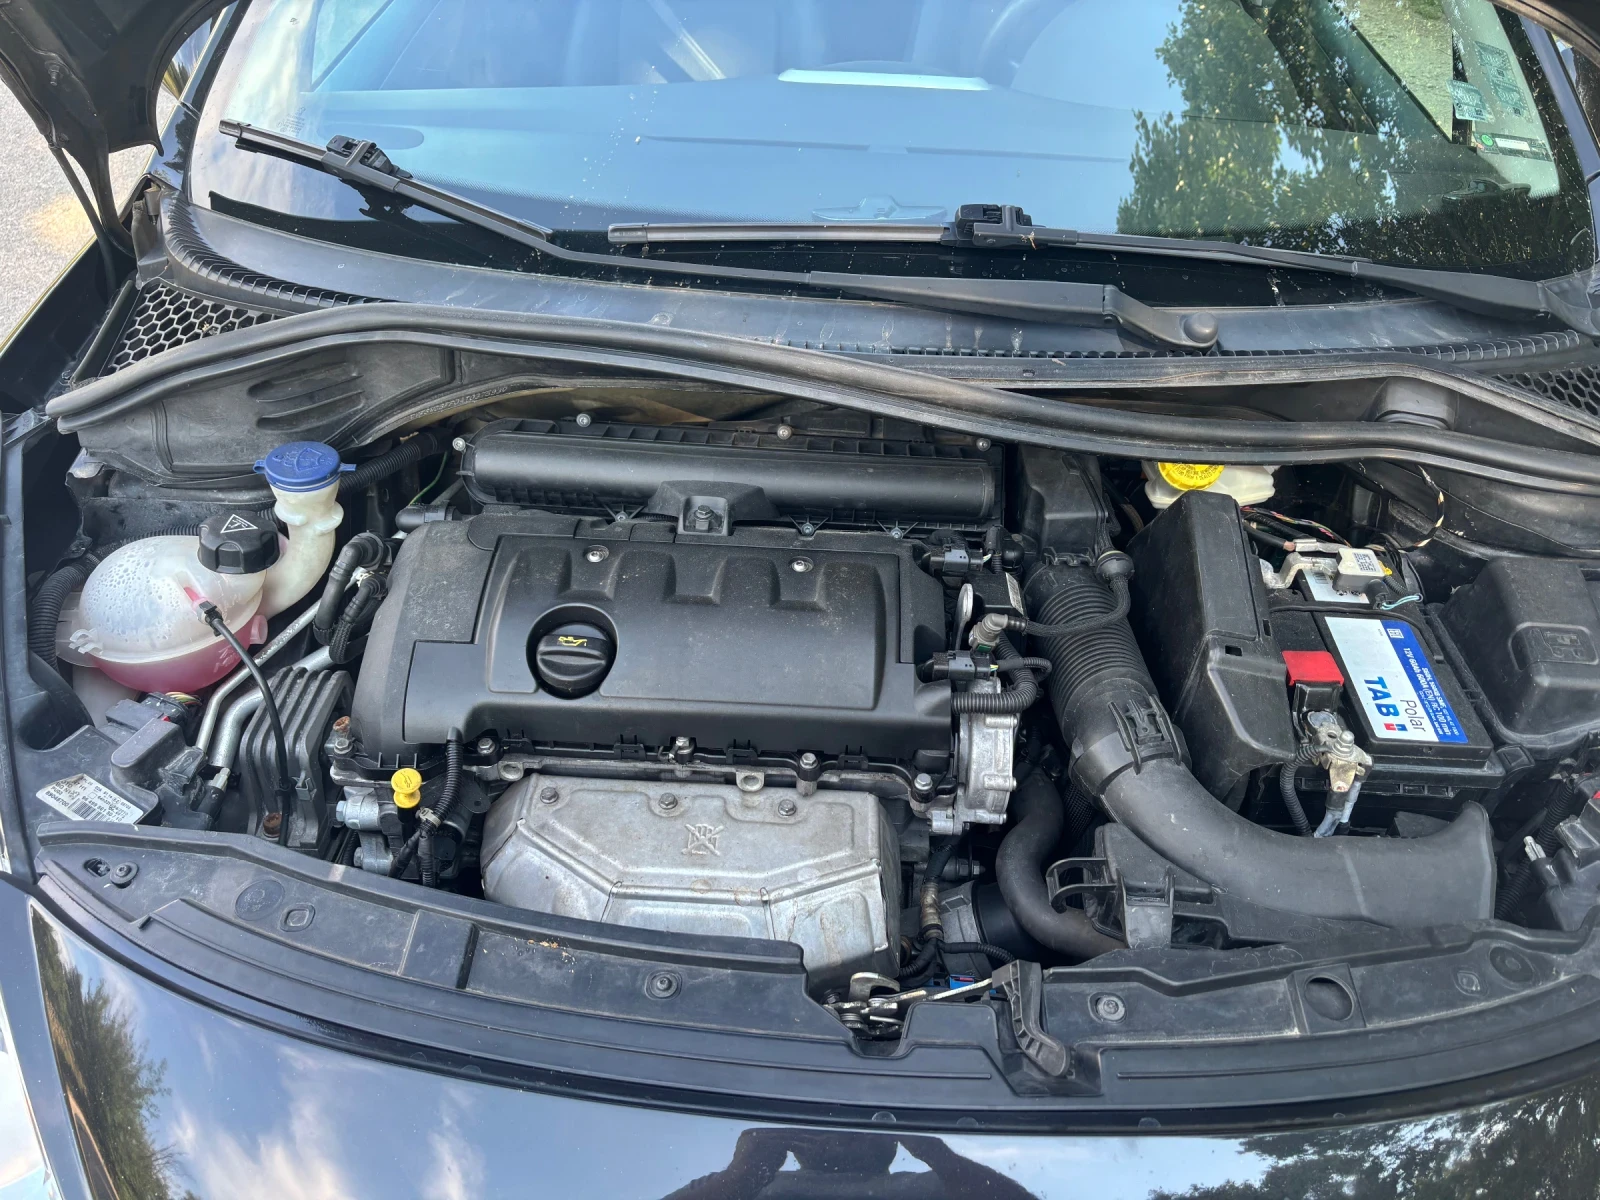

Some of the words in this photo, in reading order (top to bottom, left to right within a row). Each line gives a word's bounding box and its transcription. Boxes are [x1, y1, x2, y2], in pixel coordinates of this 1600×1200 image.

[1363, 676, 1401, 718] TAB
[1403, 647, 1414, 659] 12V
[1423, 688, 1435, 701] (EN)
[1435, 711, 1446, 723] 100
[1441, 723, 1451, 735] min
[1400, 699, 1426, 733] Polar
